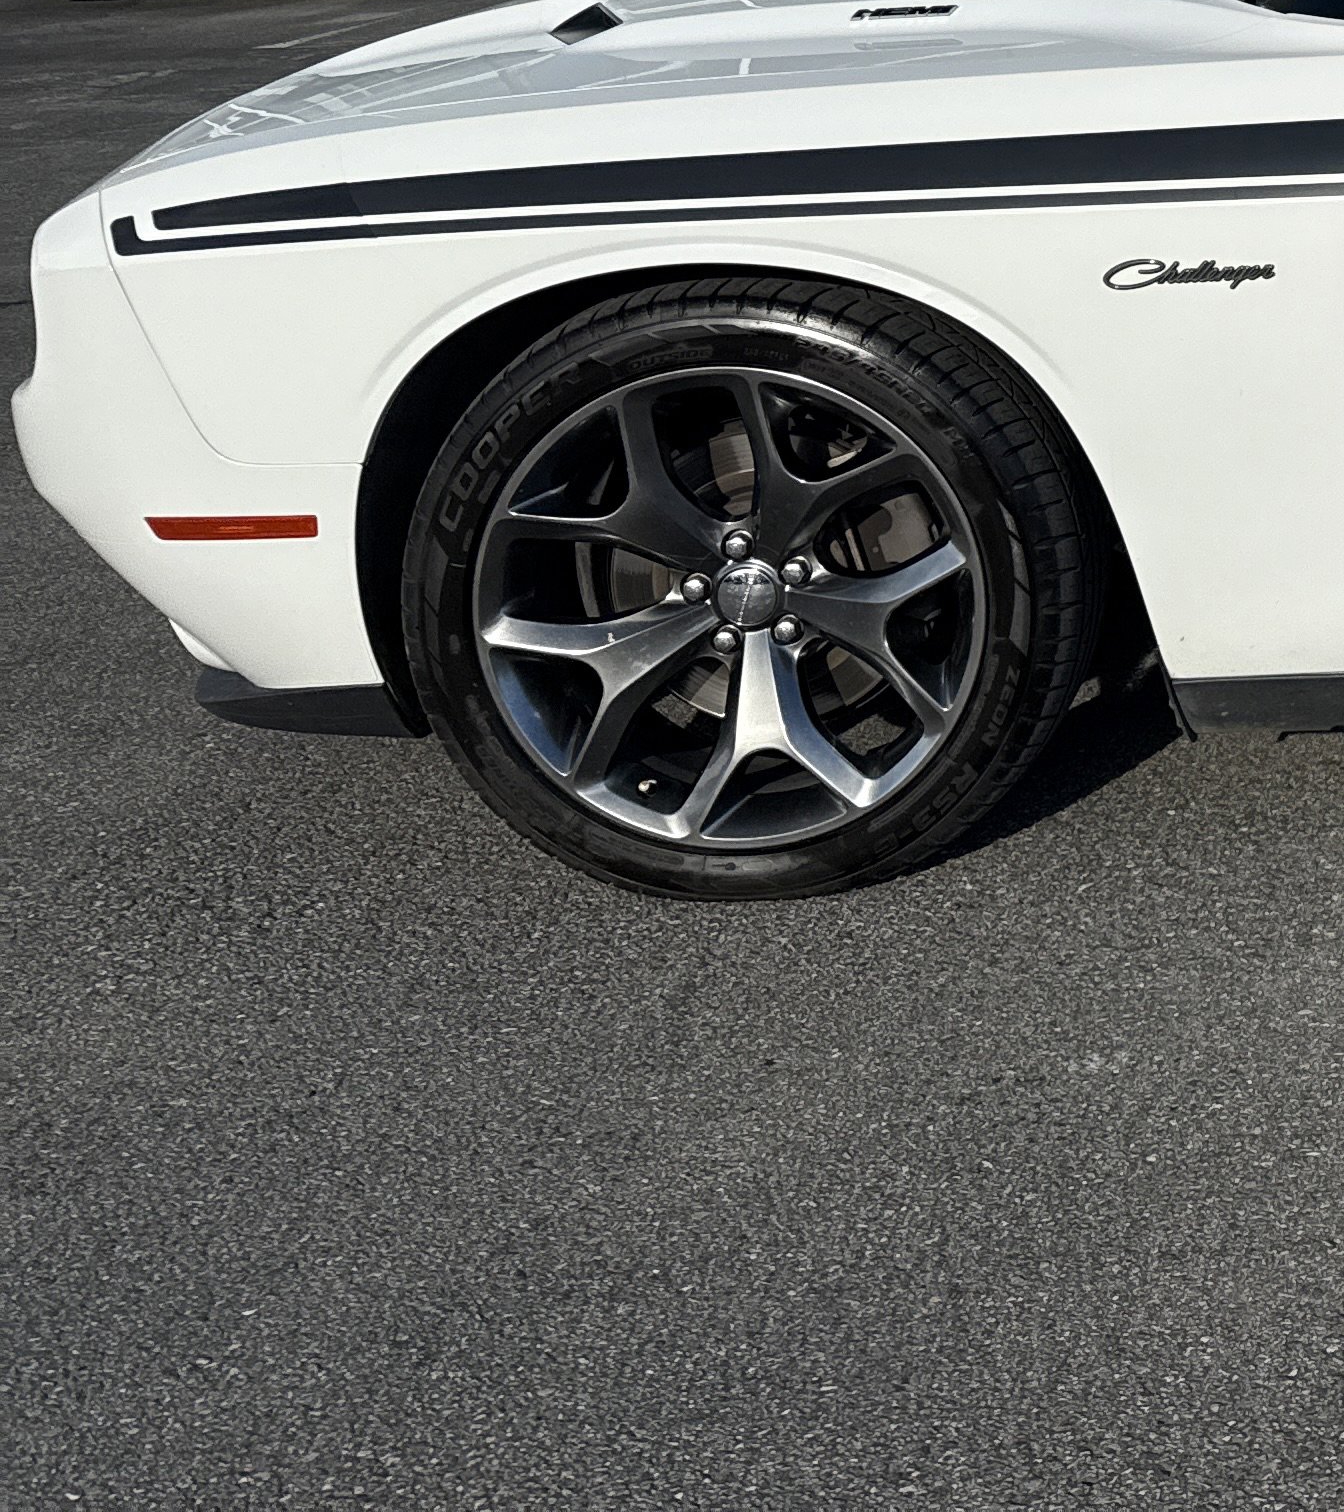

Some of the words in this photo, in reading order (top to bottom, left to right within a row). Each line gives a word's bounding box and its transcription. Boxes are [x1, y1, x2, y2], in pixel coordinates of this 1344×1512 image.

[850, 4, 959, 22] HEMI
[1102, 258, 1276, 290] Challenger
[439, 361, 582, 532] COOPER
[982, 664, 1022, 747] ZEON
